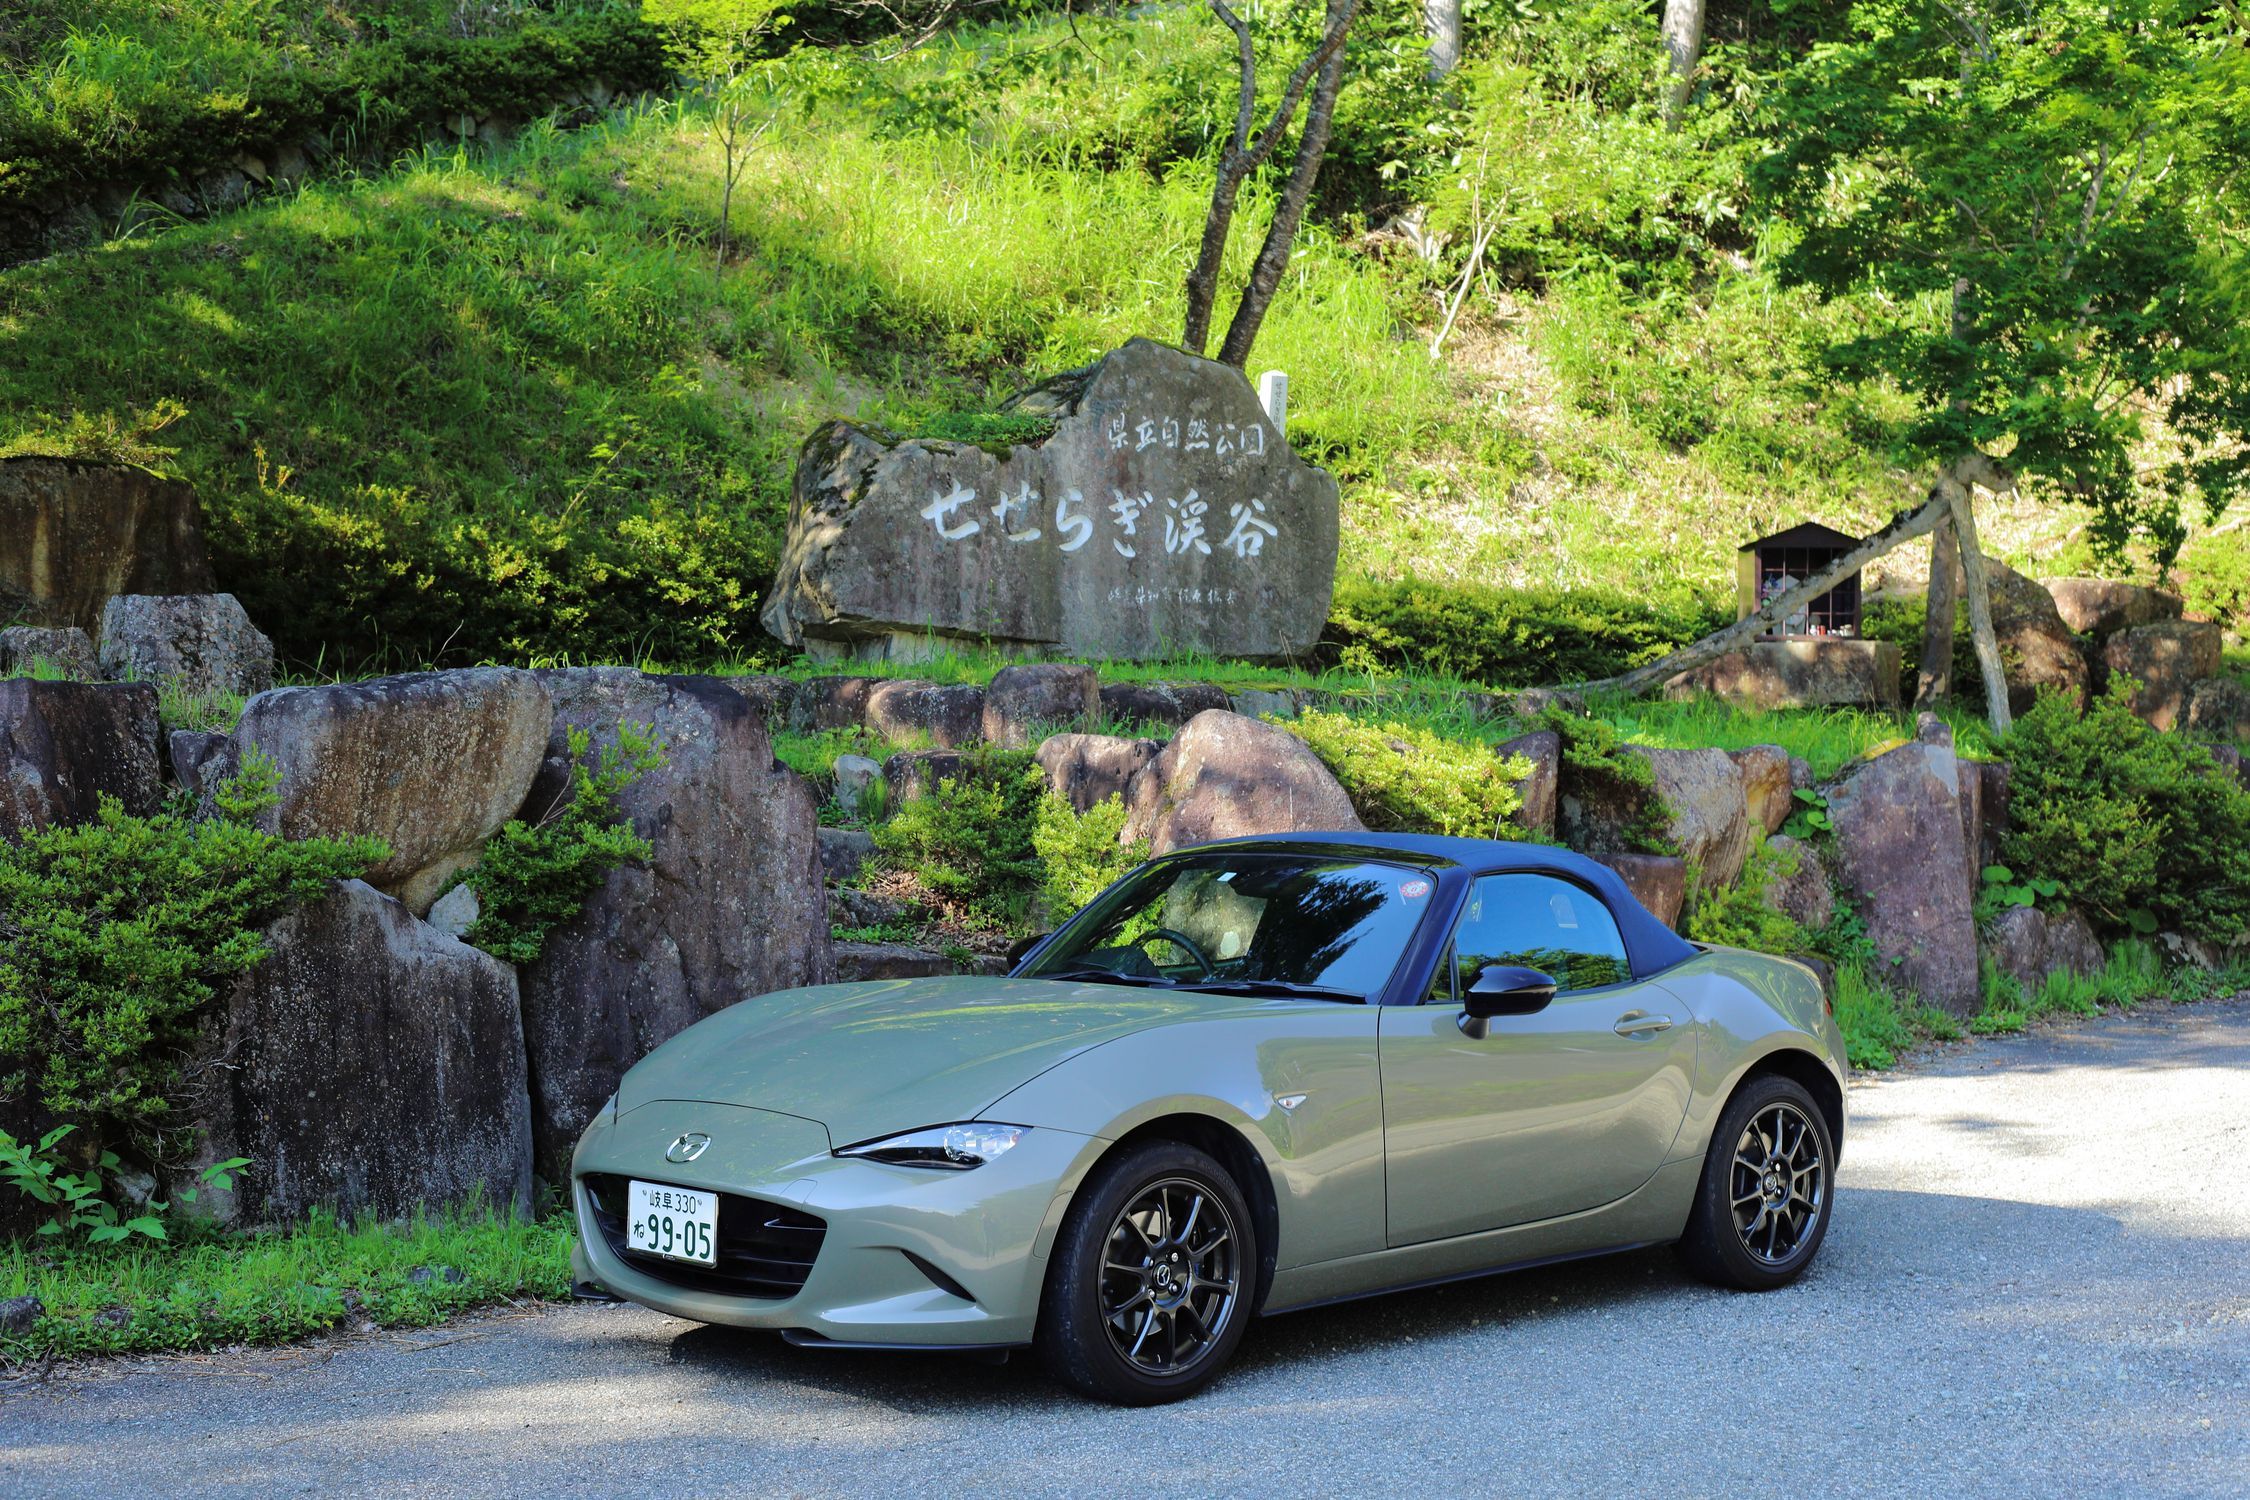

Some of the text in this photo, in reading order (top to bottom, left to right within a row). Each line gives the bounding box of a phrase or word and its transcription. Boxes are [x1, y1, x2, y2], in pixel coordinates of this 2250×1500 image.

[920, 478, 1278, 558] せせらぎ渓谷
[650, 1189, 696, 1215] 岐阜 330
[633, 1213, 711, 1260] ね 99-05
